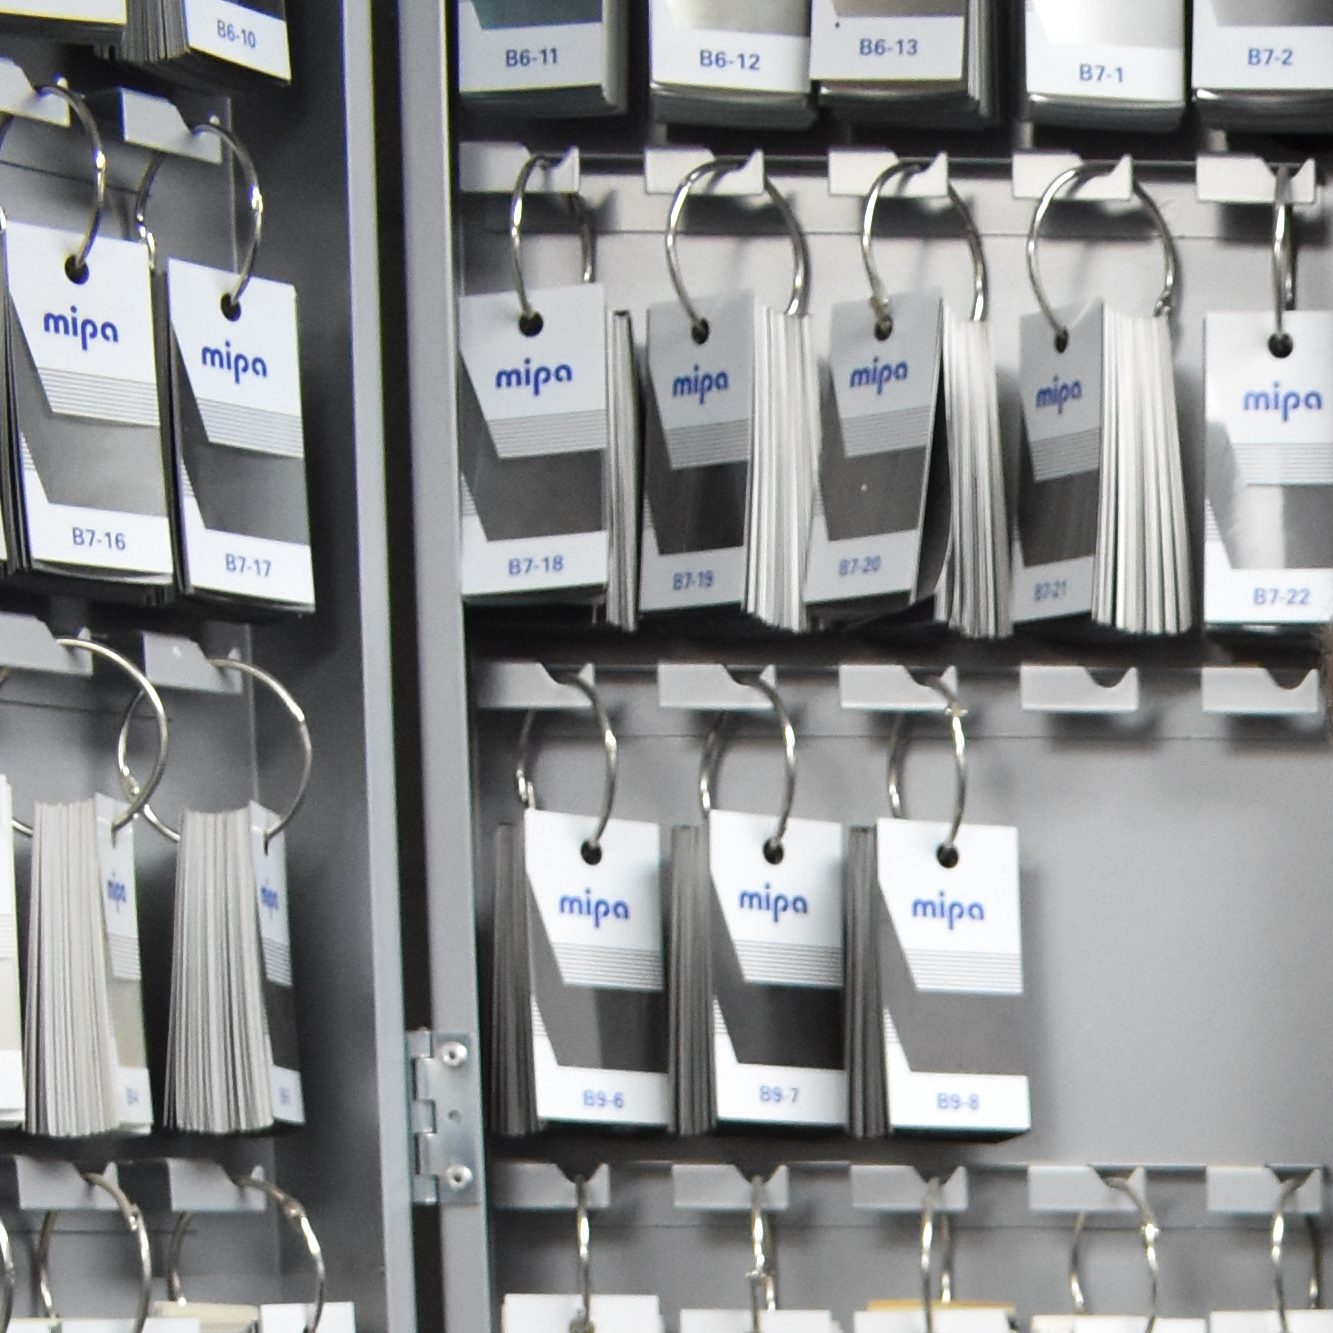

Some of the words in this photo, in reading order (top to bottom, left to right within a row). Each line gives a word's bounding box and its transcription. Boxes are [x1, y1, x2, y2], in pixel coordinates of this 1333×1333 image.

[217, 19, 257, 48] B6-10
[506, 48, 559, 69] B6-11
[859, 37, 920, 57] B6-13
[1248, 48, 1293, 66] B7-2
[700, 52, 760, 73] B6-12
[1079, 64, 1125, 82] B7-1
[43, 306, 119, 346] mipa
[202, 340, 269, 384] mipa
[495, 360, 574, 396] mipa
[672, 371, 729, 404] mipa
[849, 361, 908, 392] mipa
[1036, 380, 1082, 406] mipa
[1243, 382, 1324, 421] mipa
[72, 528, 128, 551] B7-16
[225, 552, 272, 578] B7-17
[507, 554, 565, 576] B7-18
[1252, 587, 1310, 605] B7-22
[559, 891, 630, 927] mipa
[738, 882, 808, 921] mipa
[911, 891, 985, 928] mipa
[582, 1089, 625, 1108] B9-6
[758, 1084, 800, 1104] B9-7
